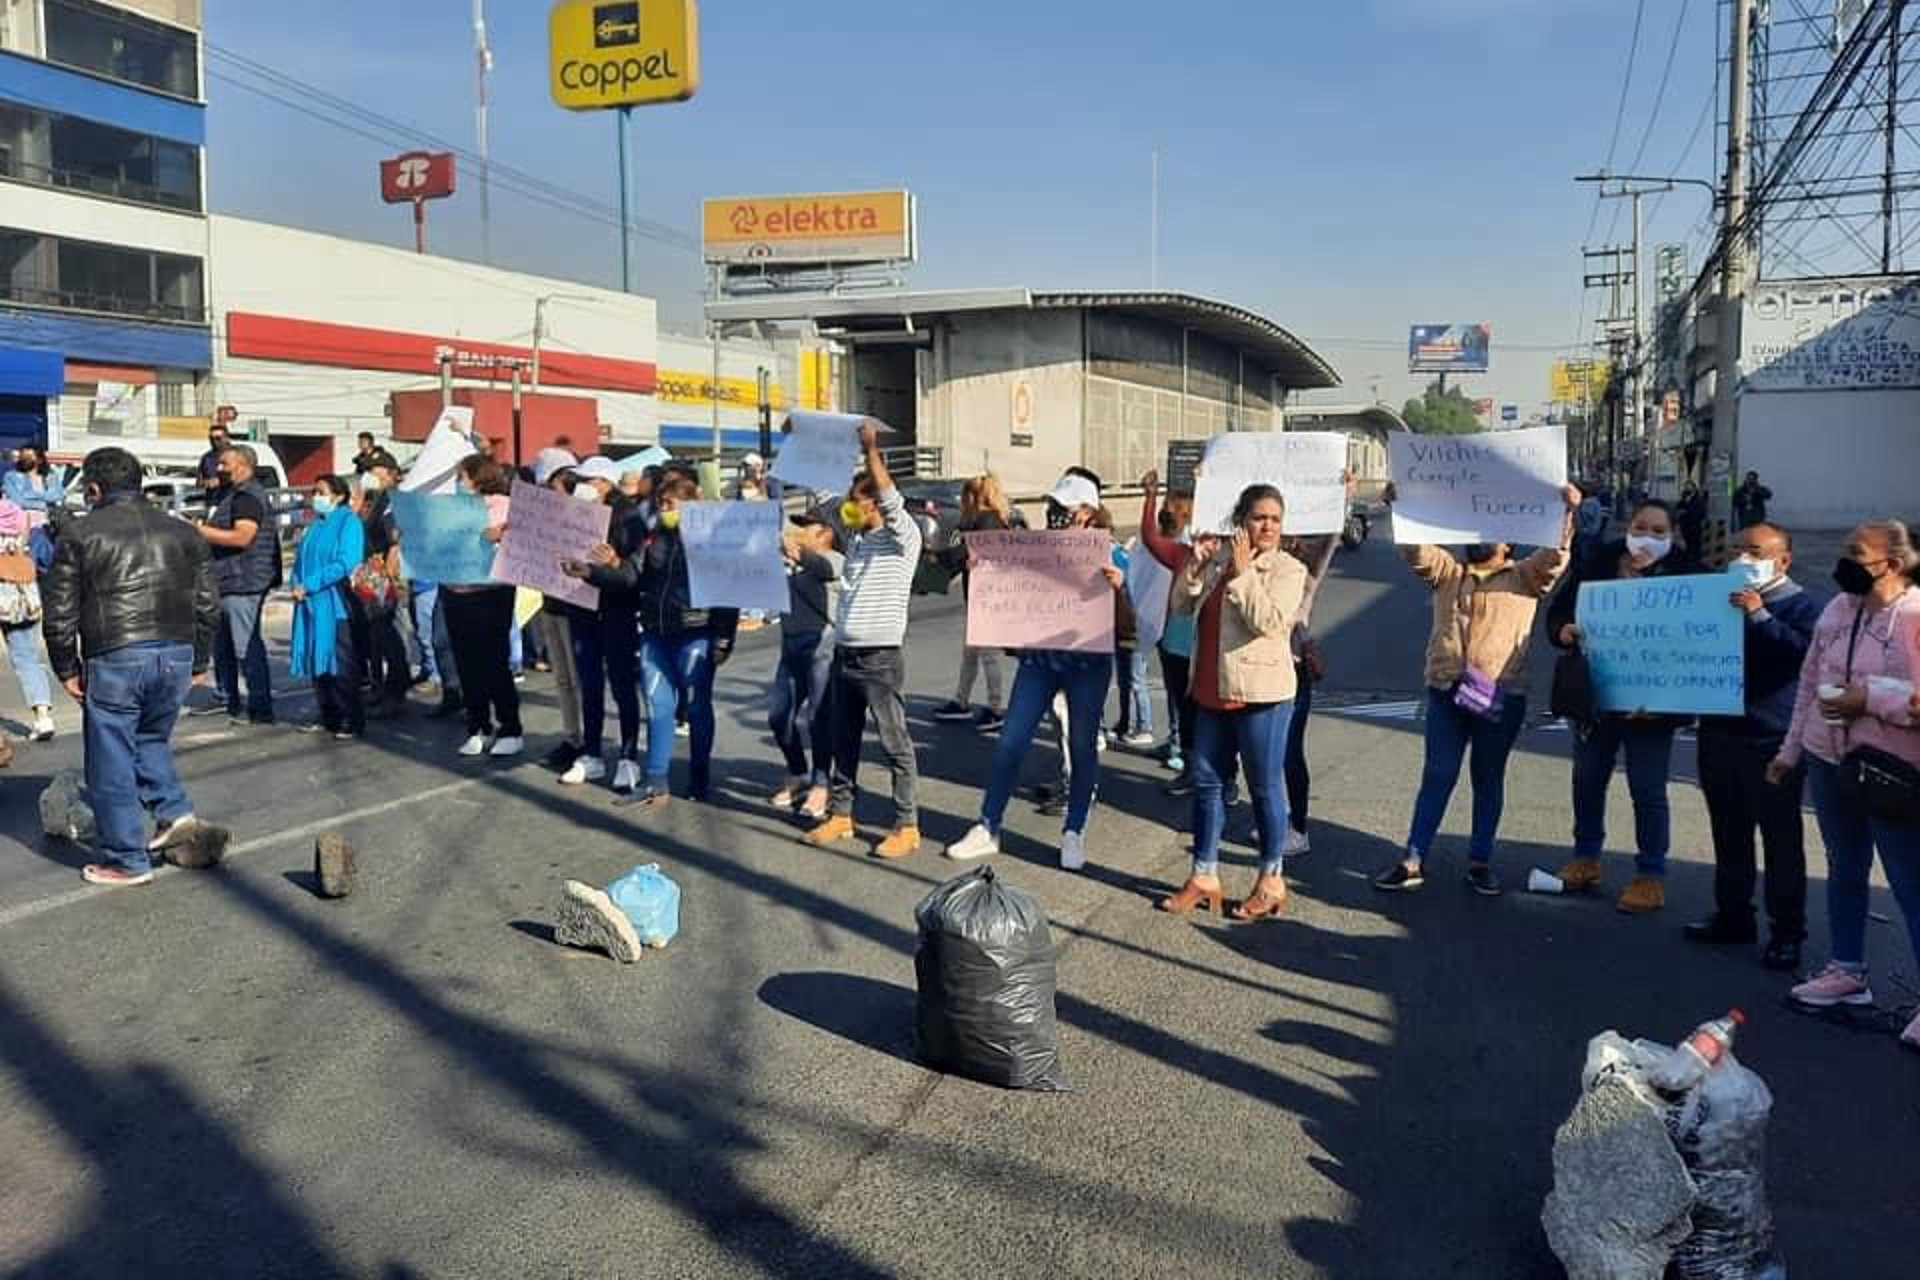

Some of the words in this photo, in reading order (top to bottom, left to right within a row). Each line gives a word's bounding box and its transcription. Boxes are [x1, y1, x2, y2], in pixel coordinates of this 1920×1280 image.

[765, 202, 878, 233] elektra
[1840, 342, 1858, 353] LA
[1865, 341, 1910, 352] VISTA
